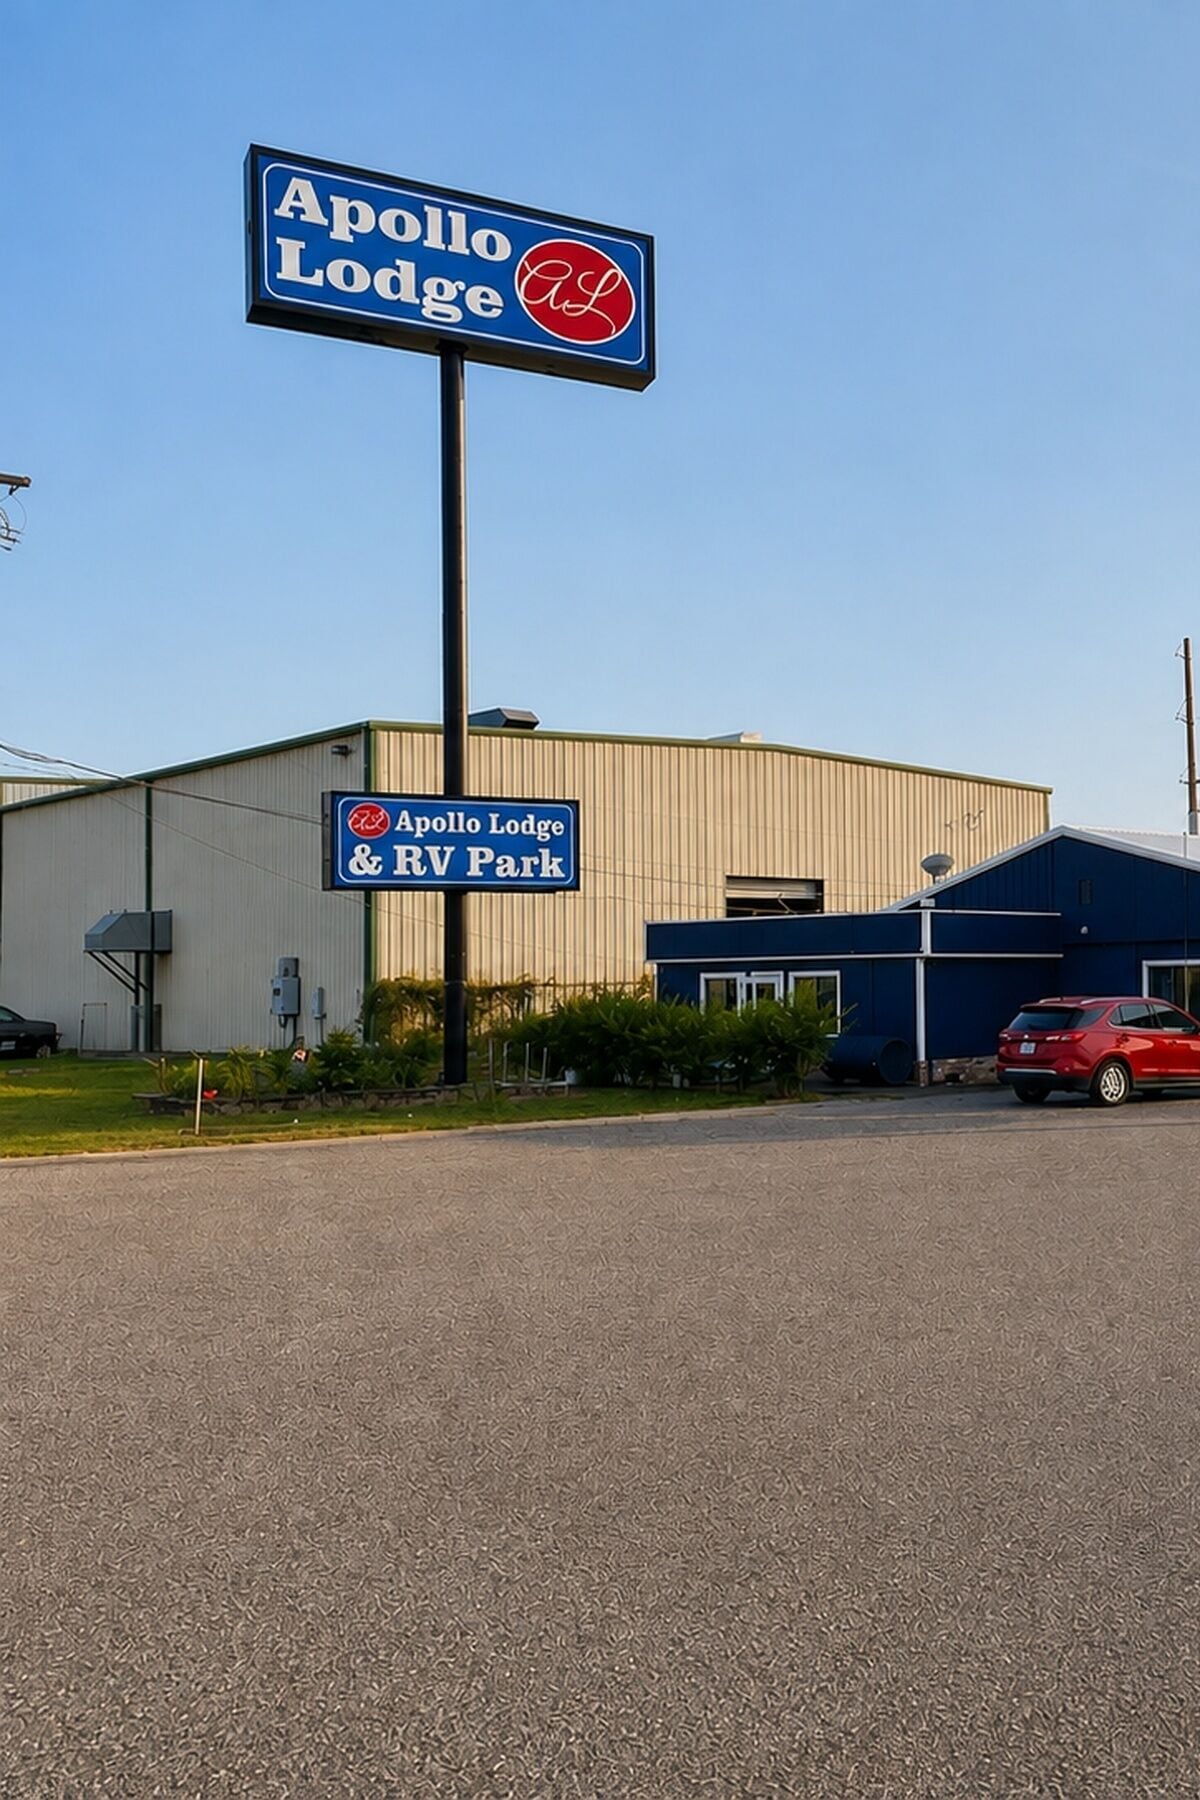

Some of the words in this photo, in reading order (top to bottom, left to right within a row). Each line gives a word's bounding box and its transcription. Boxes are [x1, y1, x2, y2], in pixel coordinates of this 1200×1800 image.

[274, 176, 512, 263] Apollo
[275, 236, 505, 324] Lodge
[394, 809, 482, 838] Apollo
[488, 812, 565, 841] Lodge
[348, 843, 383, 876] &
[392, 844, 456, 877] RV
[466, 846, 566, 879] Park
